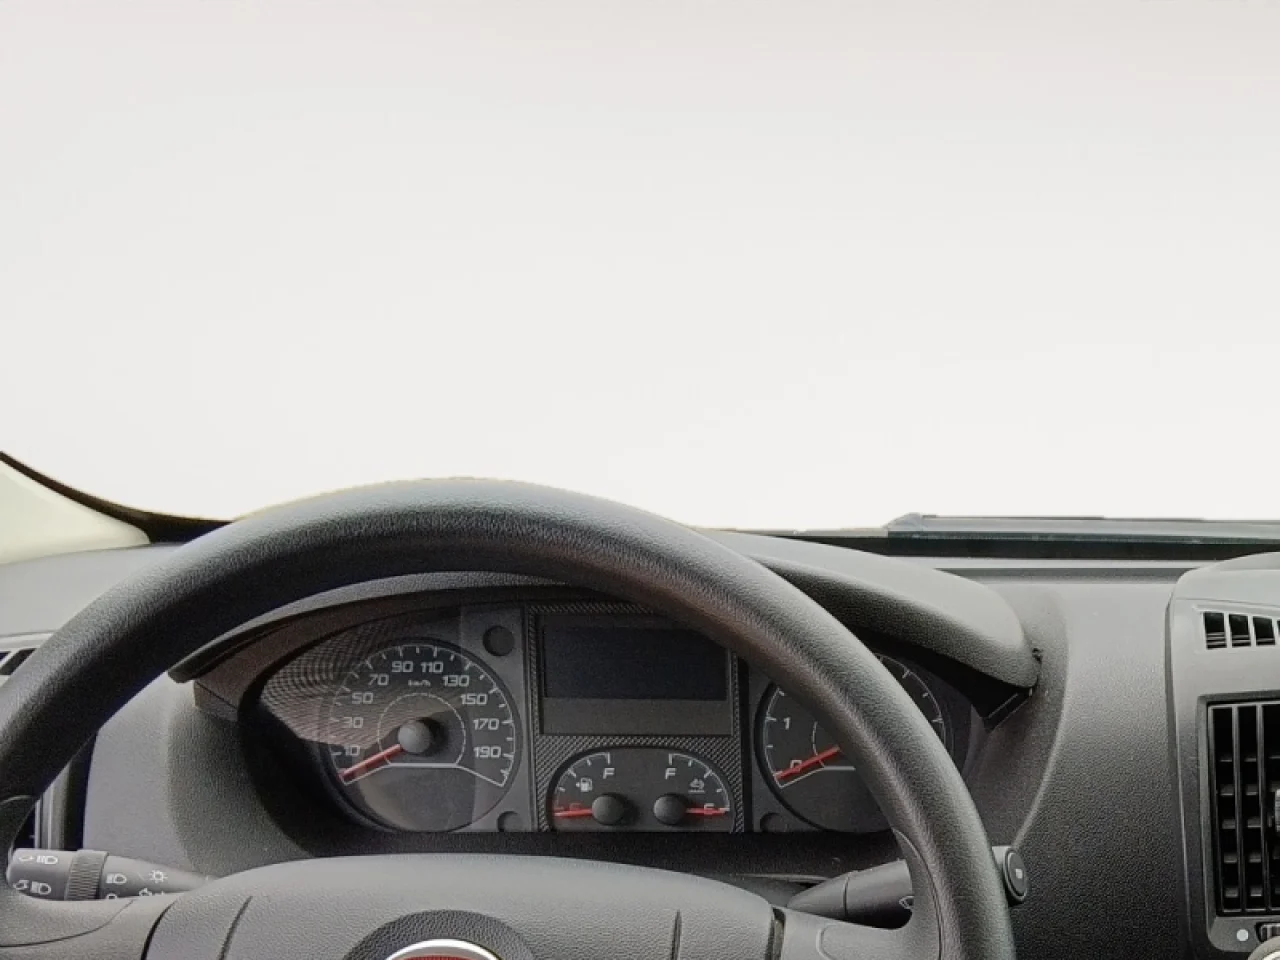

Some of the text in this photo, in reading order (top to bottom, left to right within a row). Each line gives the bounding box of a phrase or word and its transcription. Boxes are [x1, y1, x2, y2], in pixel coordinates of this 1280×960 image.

[392, 661, 413, 673] 90
[420, 662, 443, 673] 110
[368, 674, 389, 686] 70
[442, 675, 470, 687] 130
[352, 692, 374, 704] 50
[460, 693, 488, 705] 150
[343, 717, 364, 729] 30
[473, 718, 499, 730] 170
[784, 717, 790, 730] 1
[345, 745, 361, 756] 10
[473, 746, 501, 758] 190
[603, 767, 615, 779] F
[665, 767, 677, 780] F
